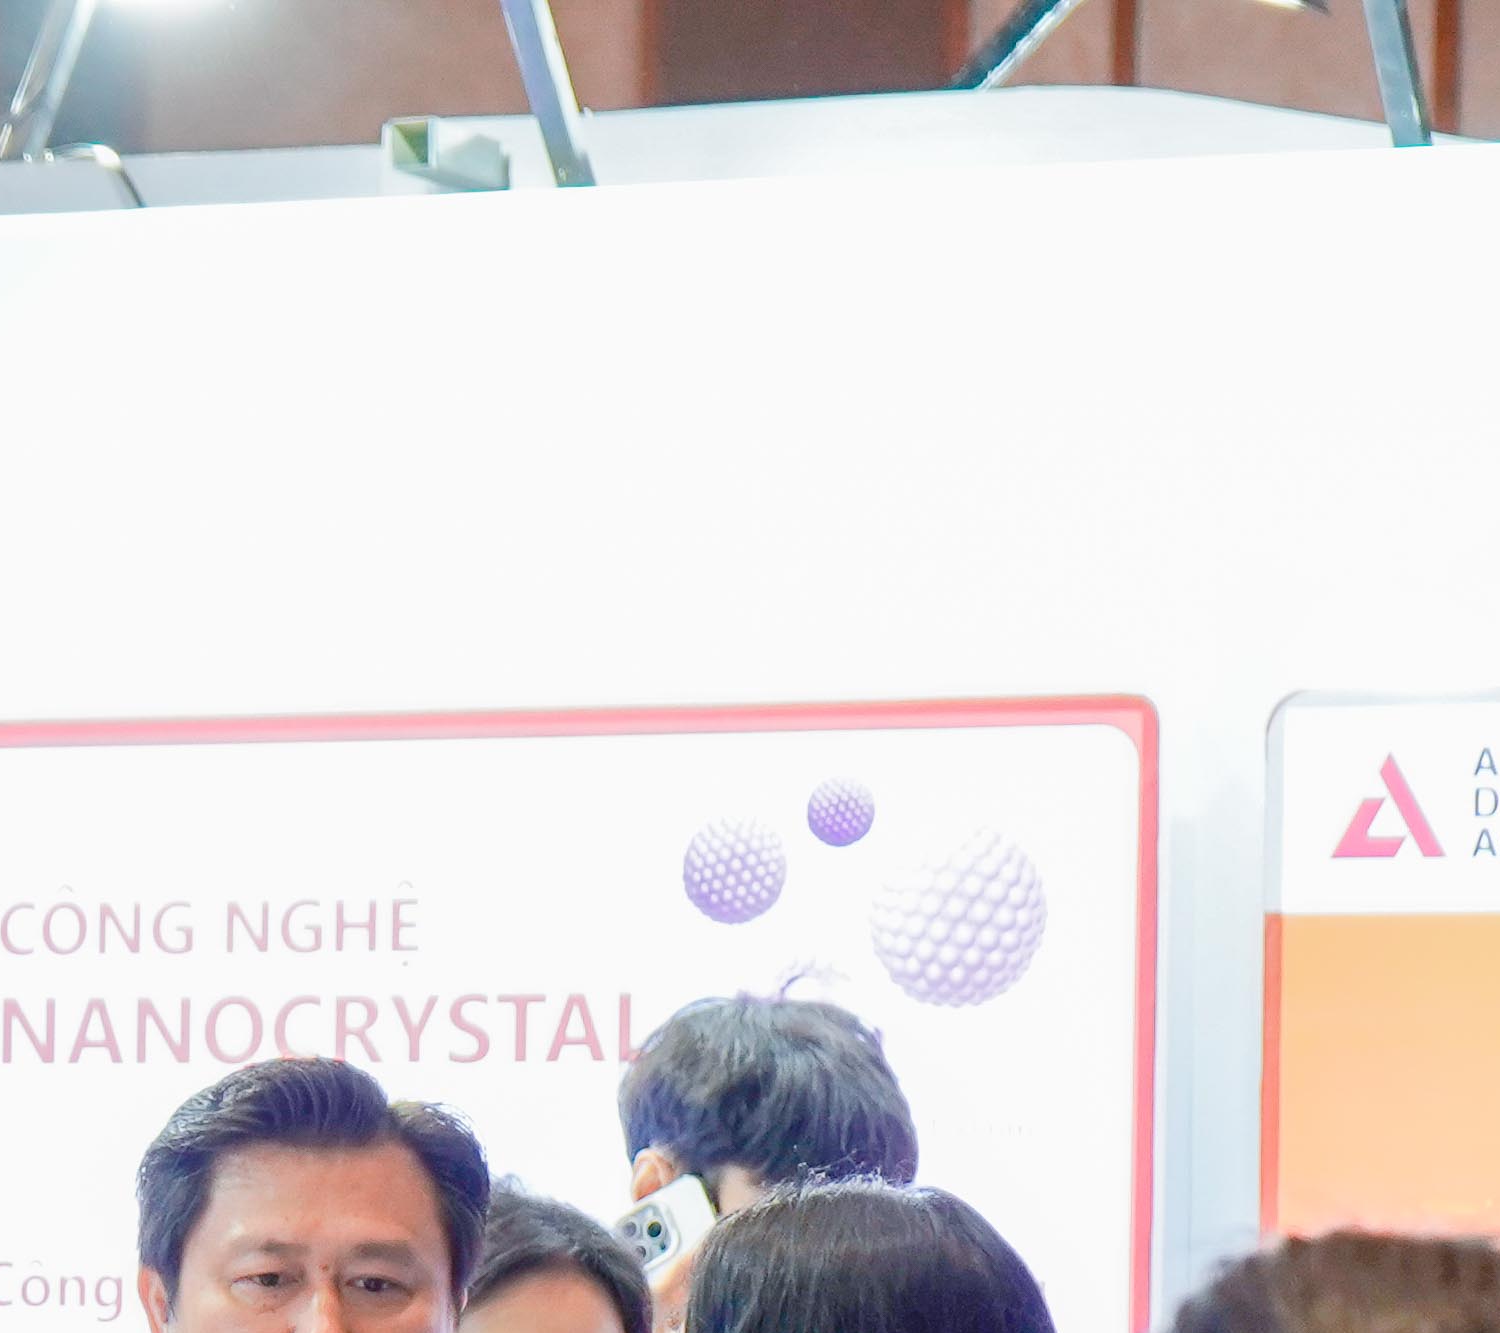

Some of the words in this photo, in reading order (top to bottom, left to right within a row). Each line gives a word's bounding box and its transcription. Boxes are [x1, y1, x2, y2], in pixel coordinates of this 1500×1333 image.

[0, 884, 195, 957] CÔNG
[225, 880, 422, 968] NGHỆ
[0, 992, 641, 1066] NANOCRYSTAL
